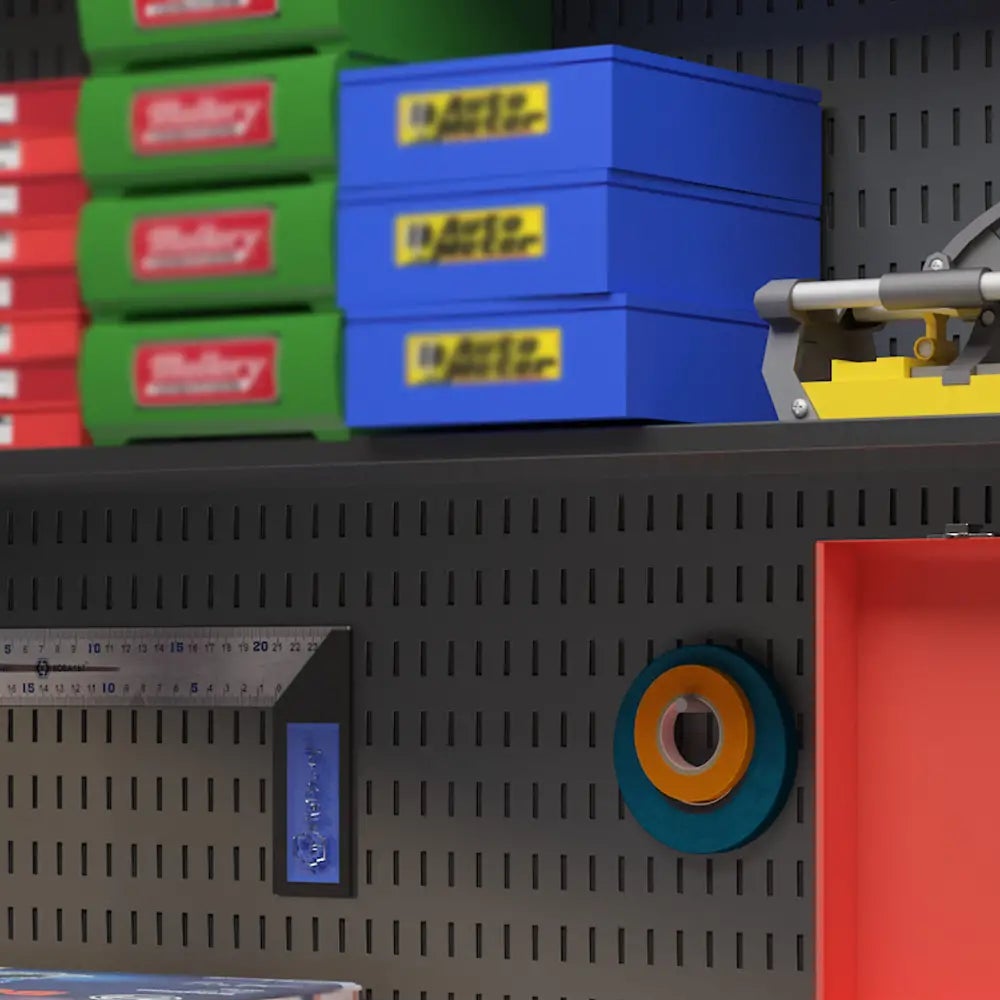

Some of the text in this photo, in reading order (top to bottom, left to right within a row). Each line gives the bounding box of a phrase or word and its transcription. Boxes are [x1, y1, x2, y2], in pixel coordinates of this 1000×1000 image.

[4, 644, 12, 654] 5
[88, 643, 101, 654] 10
[105, 645, 114, 654] 11
[121, 644, 131, 654] 12
[170, 642, 184, 652] 15
[253, 641, 268, 652] 20
[272, 643, 282, 652] 21
[290, 643, 300, 652] 22
[22, 683, 35, 693] 15
[39, 684, 48, 693] 14
[71, 684, 80, 693] 12
[102, 683, 116, 693] 10
[191, 683, 198, 693] 5
